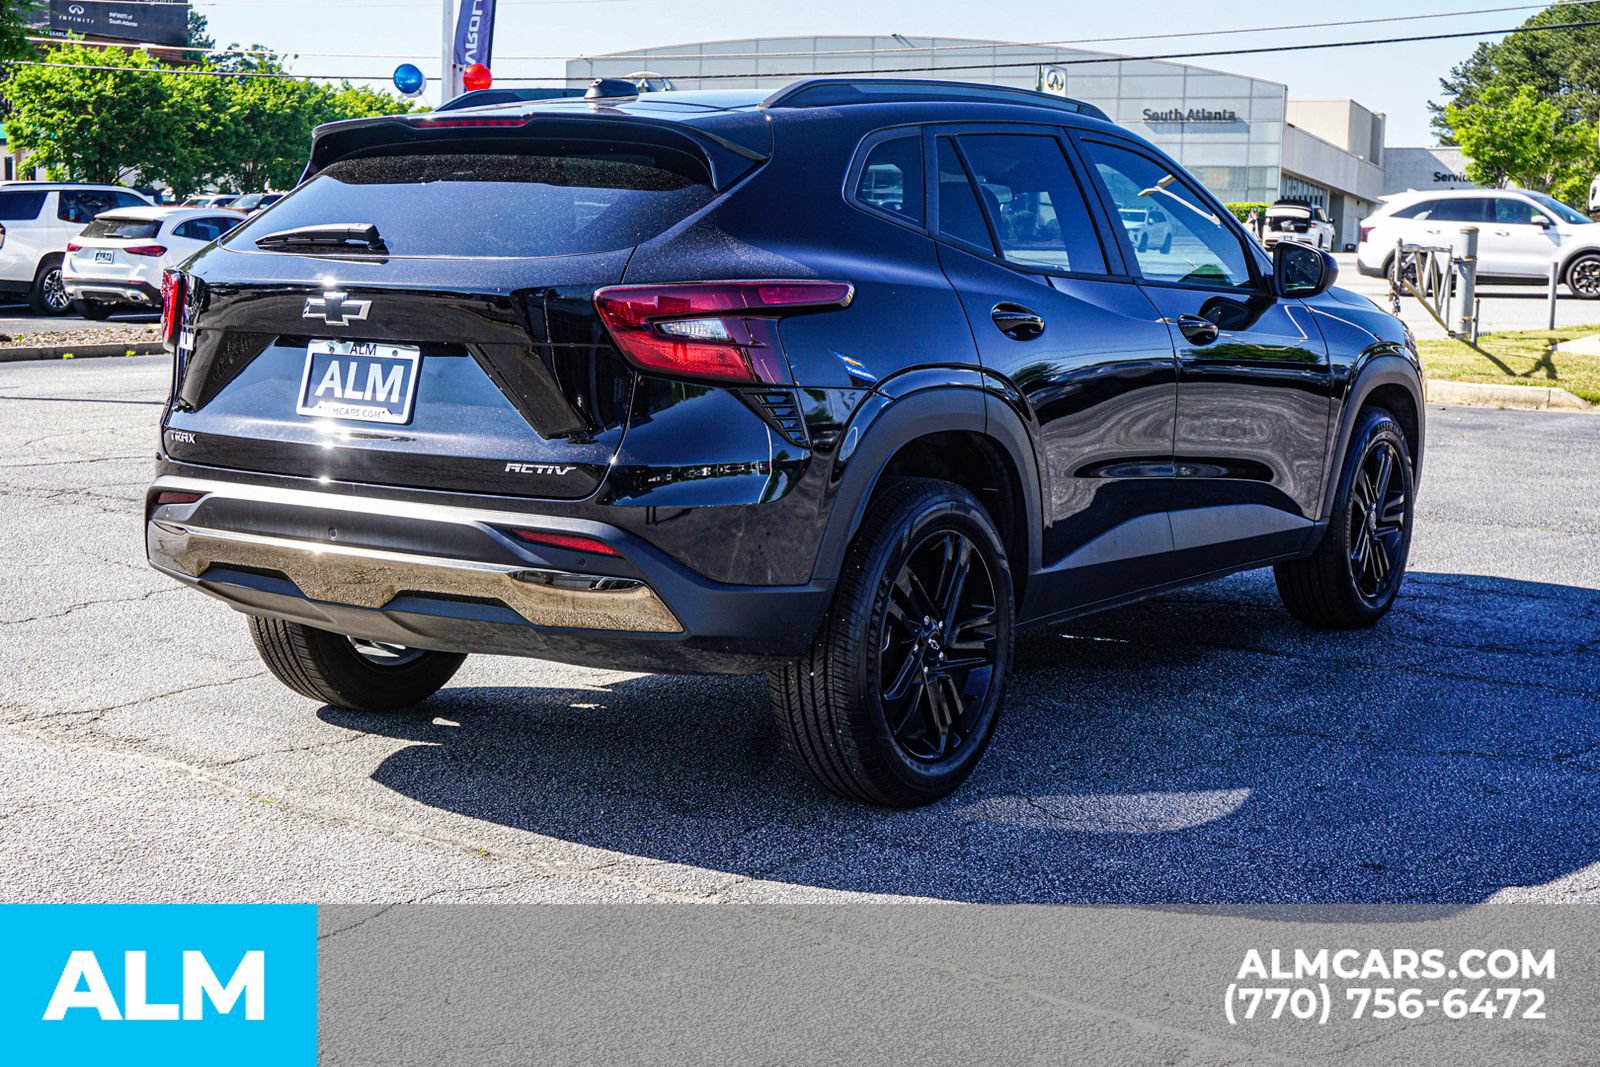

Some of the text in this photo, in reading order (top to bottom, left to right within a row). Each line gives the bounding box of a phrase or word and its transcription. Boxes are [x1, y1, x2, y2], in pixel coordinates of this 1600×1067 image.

[58, 15, 94, 24] INFINITI
[1142, 107, 1236, 121] South Atlanta
[1433, 171, 1472, 182] Servic
[349, 343, 377, 356] ALM
[314, 360, 405, 403] ALM
[170, 430, 196, 444] TRAX
[504, 462, 577, 475] ACTIV
